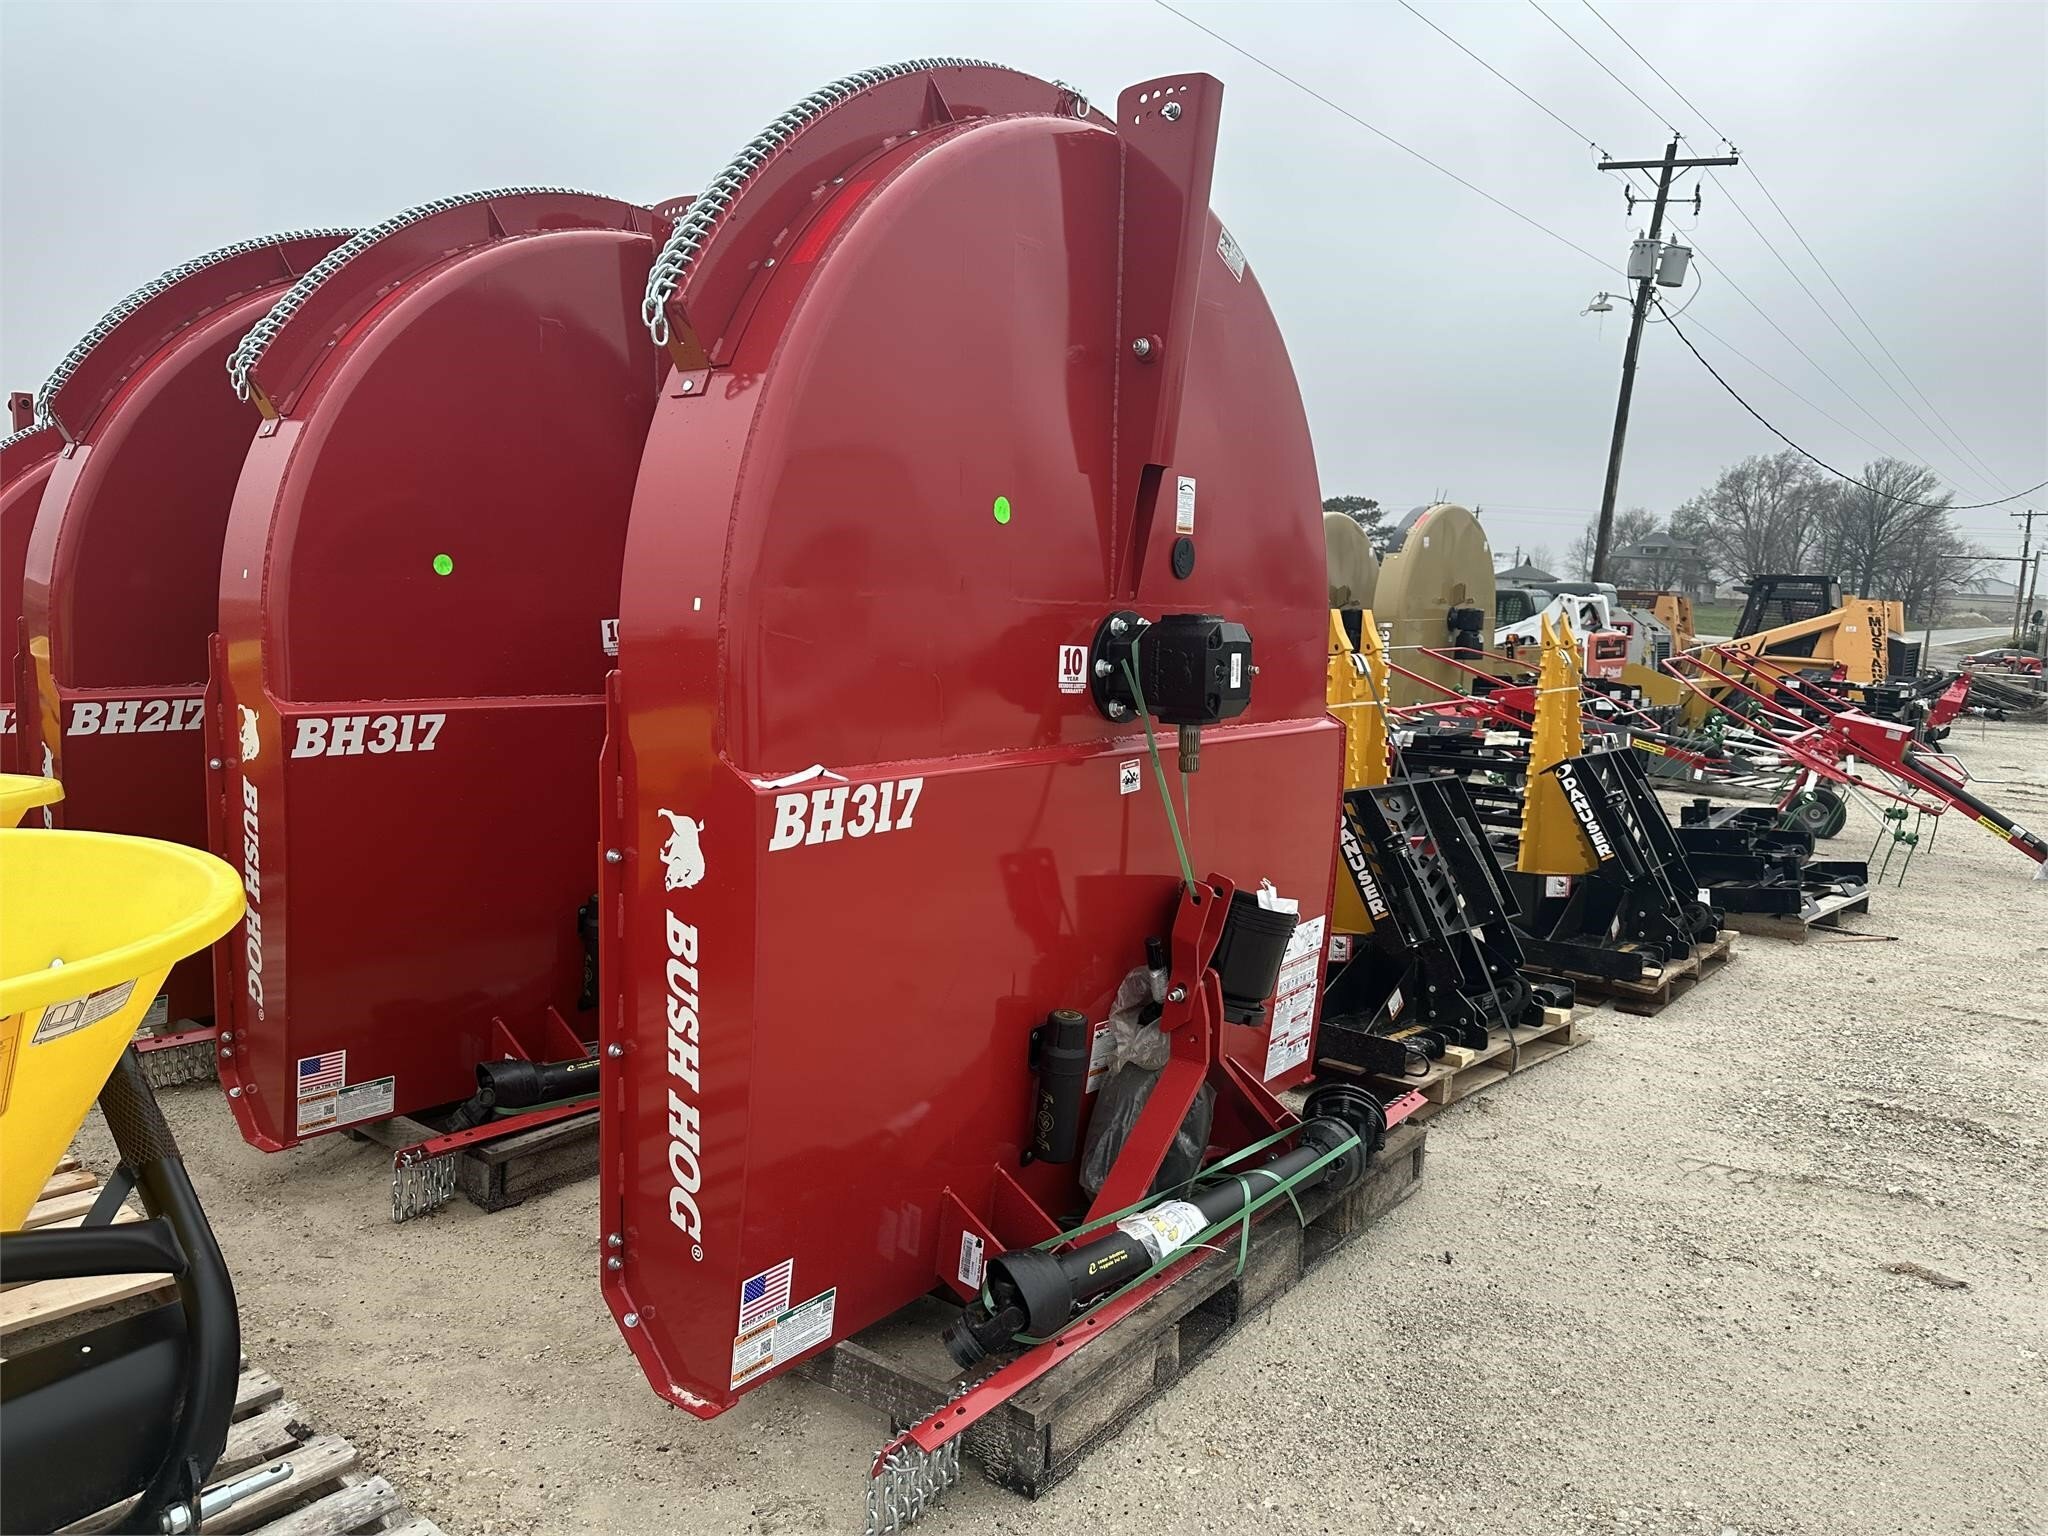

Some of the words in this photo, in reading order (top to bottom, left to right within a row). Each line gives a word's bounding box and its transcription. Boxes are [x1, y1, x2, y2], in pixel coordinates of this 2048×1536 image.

[1064, 648, 1083, 675] 10
[67, 699, 205, 736] BH217
[291, 714, 446, 759] BH317
[243, 775, 261, 904] BUSH
[768, 778, 924, 852] BH317
[1562, 778, 1613, 858] DANUSER
[666, 909, 700, 1093] BUSH
[776, 1303, 786, 1312] USA
